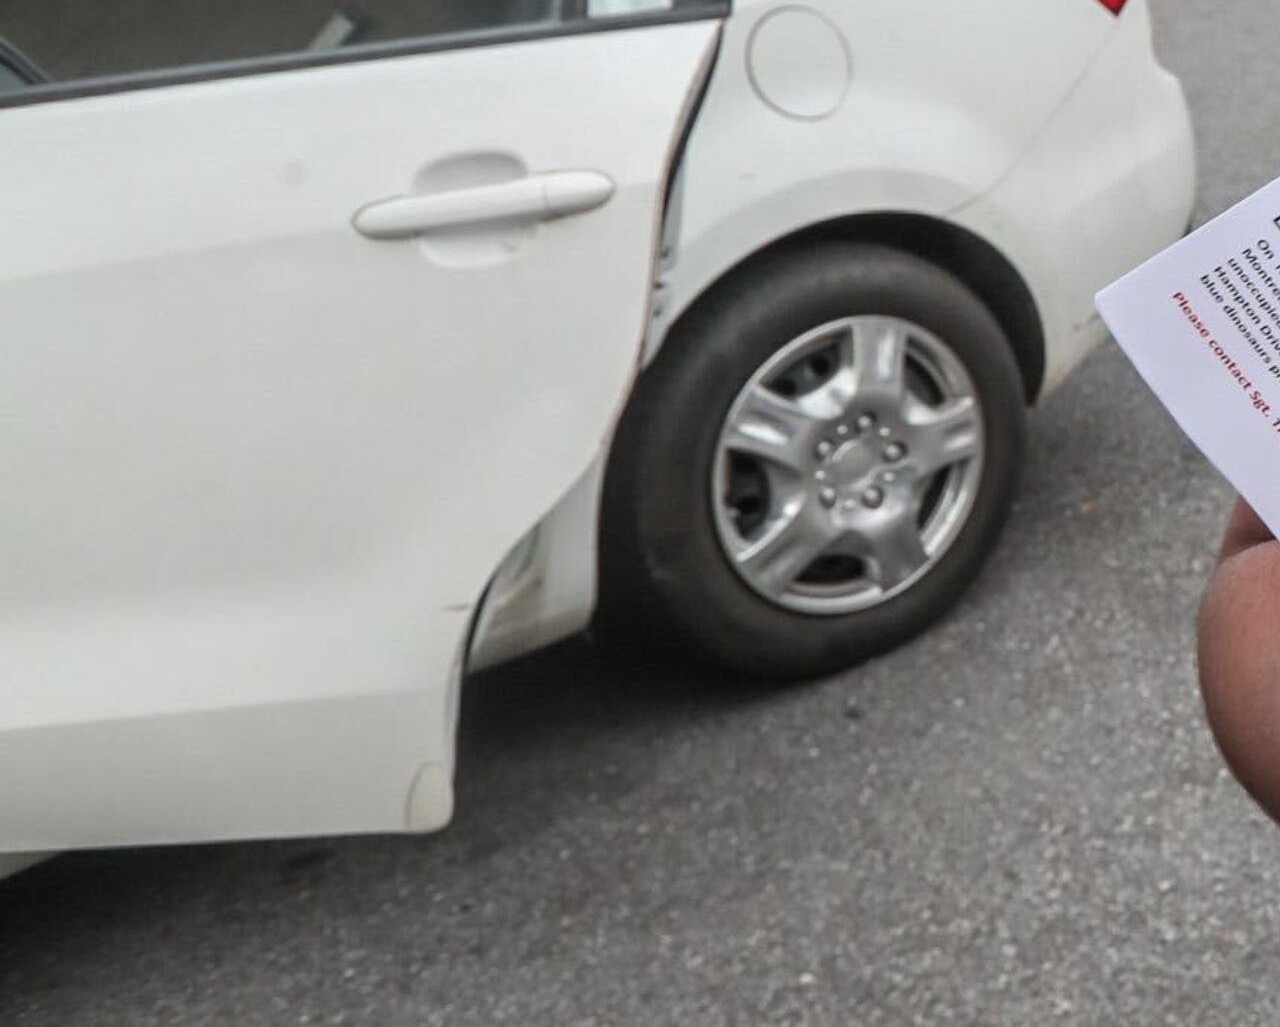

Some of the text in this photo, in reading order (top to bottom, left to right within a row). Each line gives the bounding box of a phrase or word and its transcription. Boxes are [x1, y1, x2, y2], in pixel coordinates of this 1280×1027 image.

[1257, 239, 1274, 260] On
[1200, 274, 1224, 303] blue
[1223, 305, 1271, 364] dinosaurs
[1213, 266, 1261, 325] Hampton
[1172, 291, 1210, 338] Please
[1208, 339, 1252, 390] contact
[1249, 390, 1270, 418] Sgt.
